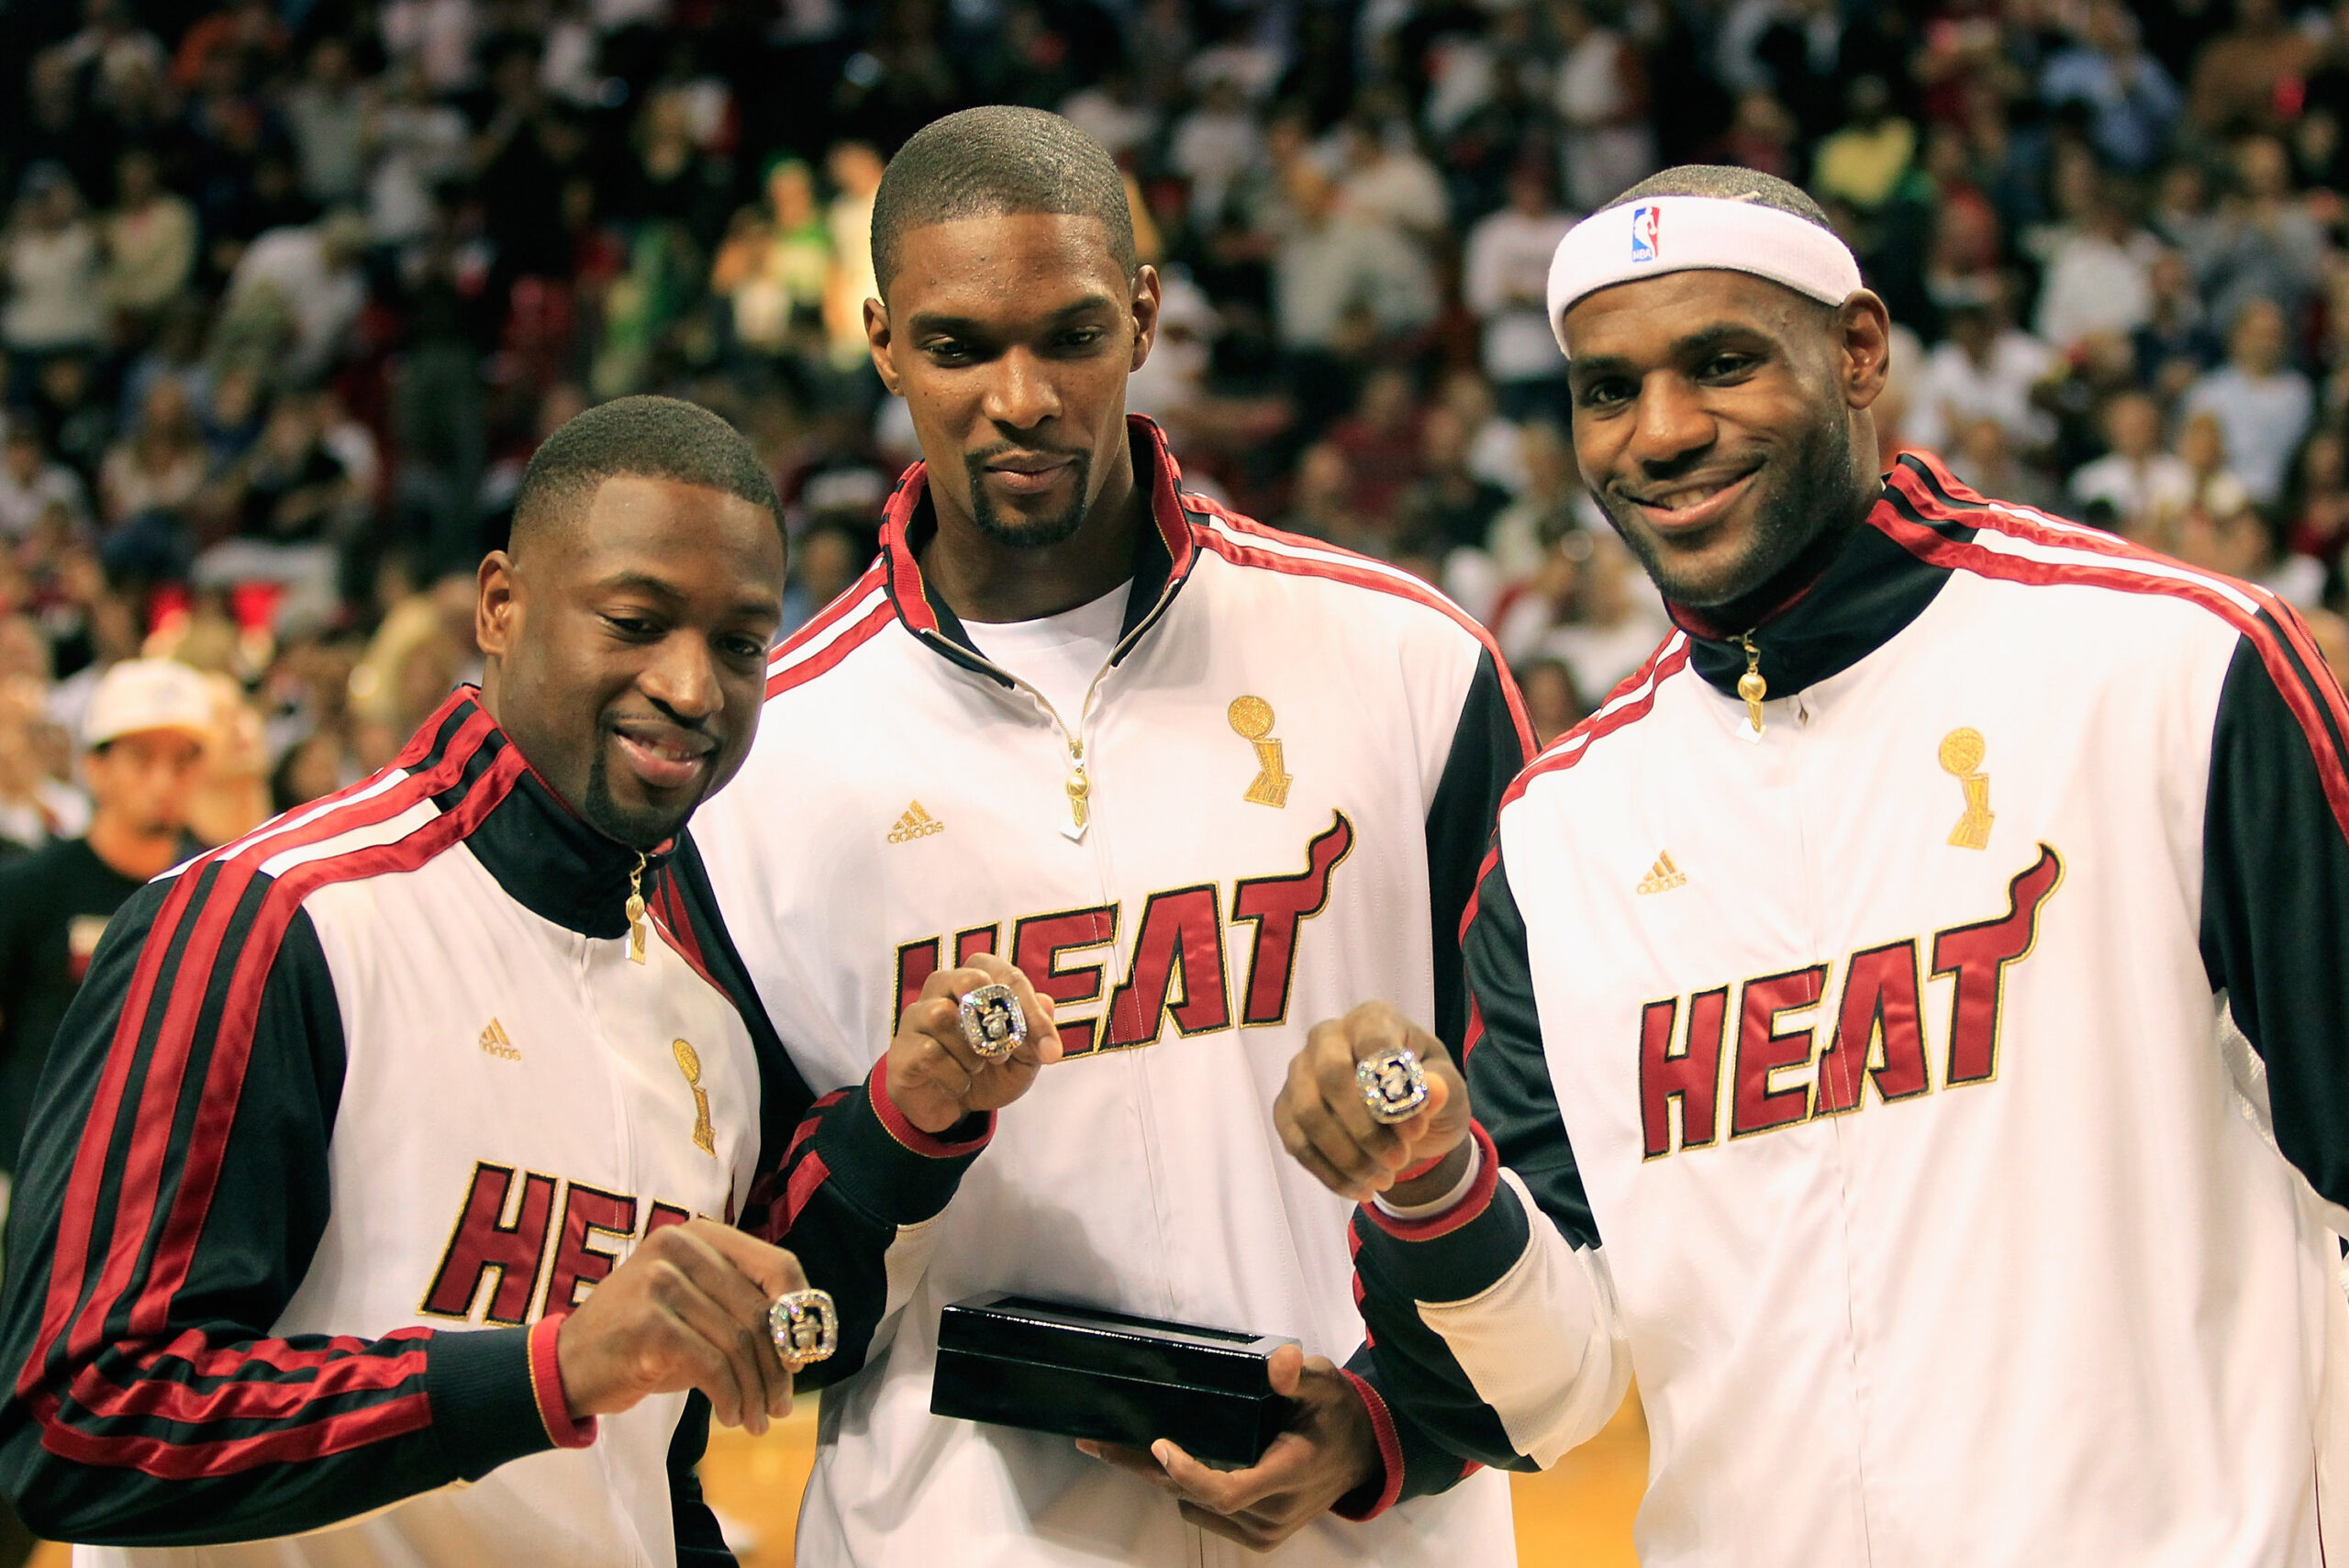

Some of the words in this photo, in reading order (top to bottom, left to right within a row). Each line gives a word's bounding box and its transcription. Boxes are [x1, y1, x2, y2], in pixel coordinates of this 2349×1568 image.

[1632, 247, 1653, 261] NBA
[887, 821, 944, 844] adidas
[1636, 873, 1687, 895] adidas
[1639, 840, 2066, 1164] HEAT
[416, 1159, 734, 1328] HE
